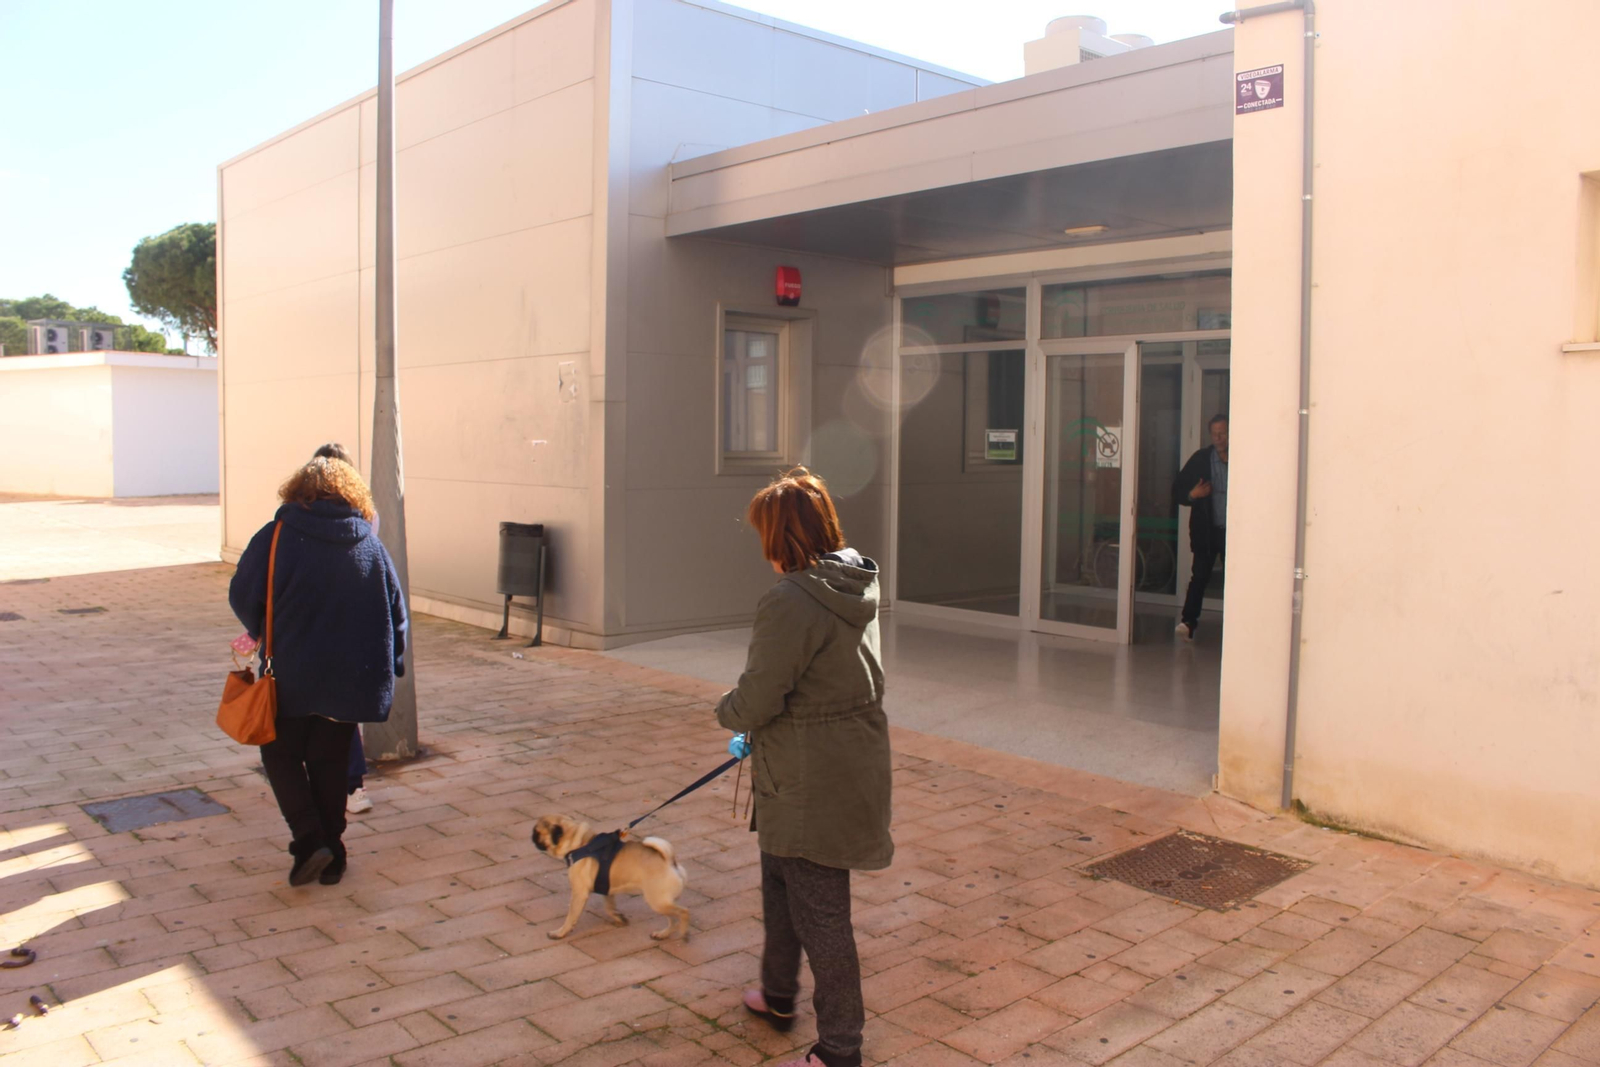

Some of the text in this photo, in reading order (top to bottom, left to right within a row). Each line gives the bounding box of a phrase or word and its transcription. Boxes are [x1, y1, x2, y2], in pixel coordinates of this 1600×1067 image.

[1240, 67, 1279, 80] VIDEOALARMA
[1241, 82, 1252, 93] 24
[1243, 98, 1276, 109] CONECTADA
